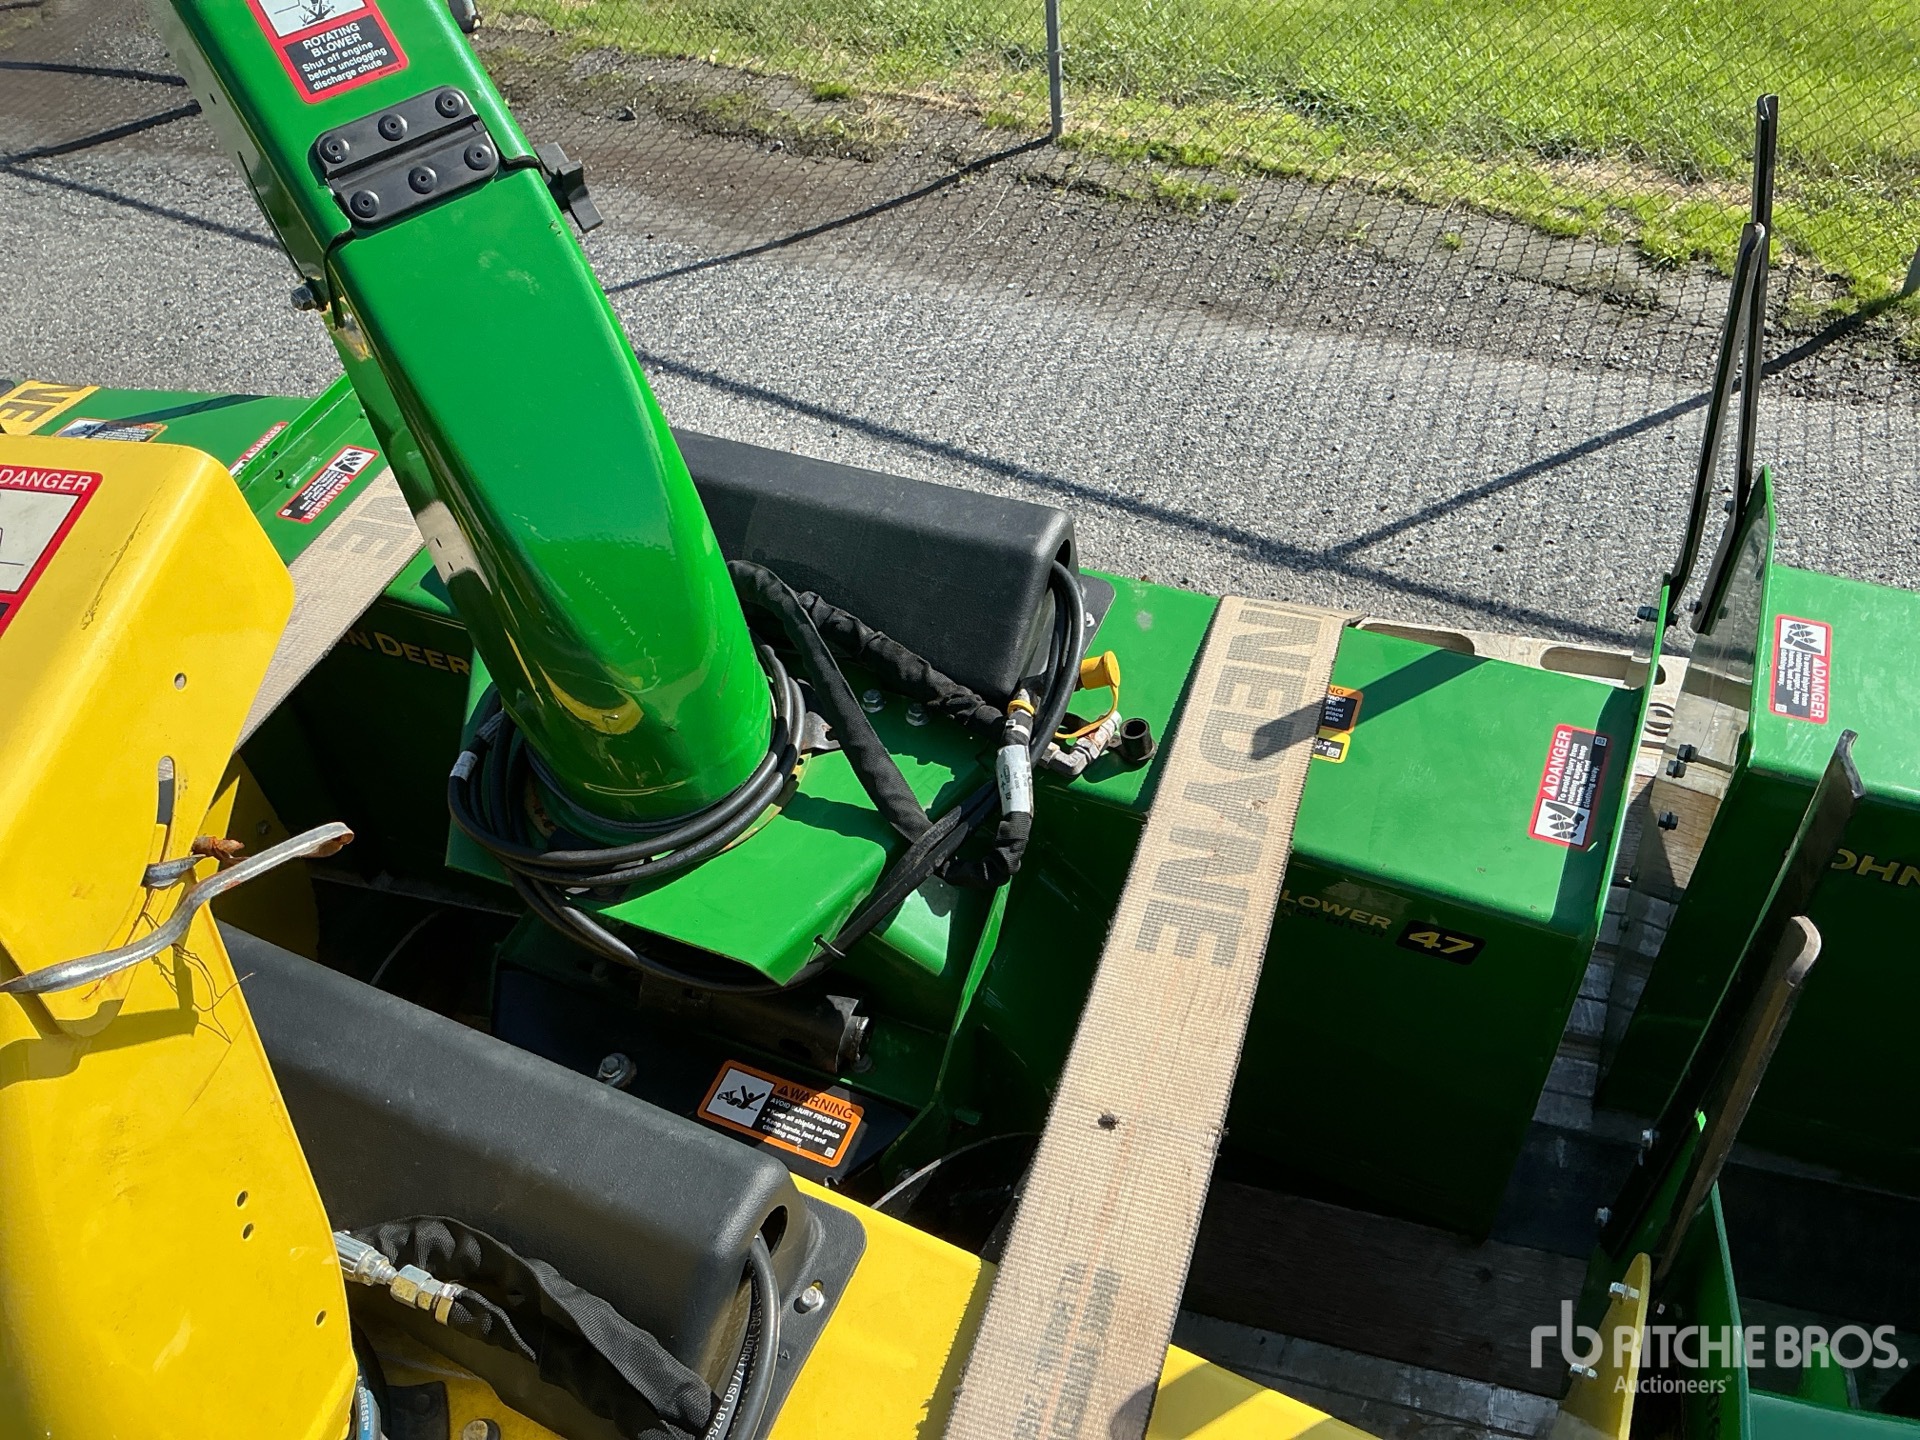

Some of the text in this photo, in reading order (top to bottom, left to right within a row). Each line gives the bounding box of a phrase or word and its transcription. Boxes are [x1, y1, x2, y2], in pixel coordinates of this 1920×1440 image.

[302, 22, 360, 49] ROTATING
[311, 32, 362, 57] BLOWER
[302, 41, 374, 72] Shut off engine
[307, 66, 337, 81] before
[338, 47, 388, 71] unclogging
[313, 68, 357, 91] discharge
[358, 59, 383, 74] chute
[0, 469, 92, 491] DANGER
[304, 482, 347, 520] DANGER
[1811, 667, 1827, 719] DANGER
[1545, 730, 1572, 787] DANGER
[1408, 931, 1474, 954] 47
[770, 1097, 790, 1109] AVOID
[812, 1111, 833, 1125] FROM
[831, 1118, 847, 1130] PTO
[789, 1086, 855, 1119] WARNING
[813, 1135, 827, 1145] and
[822, 1128, 840, 1140] place
[724, 1382, 738, 1403] ISO
